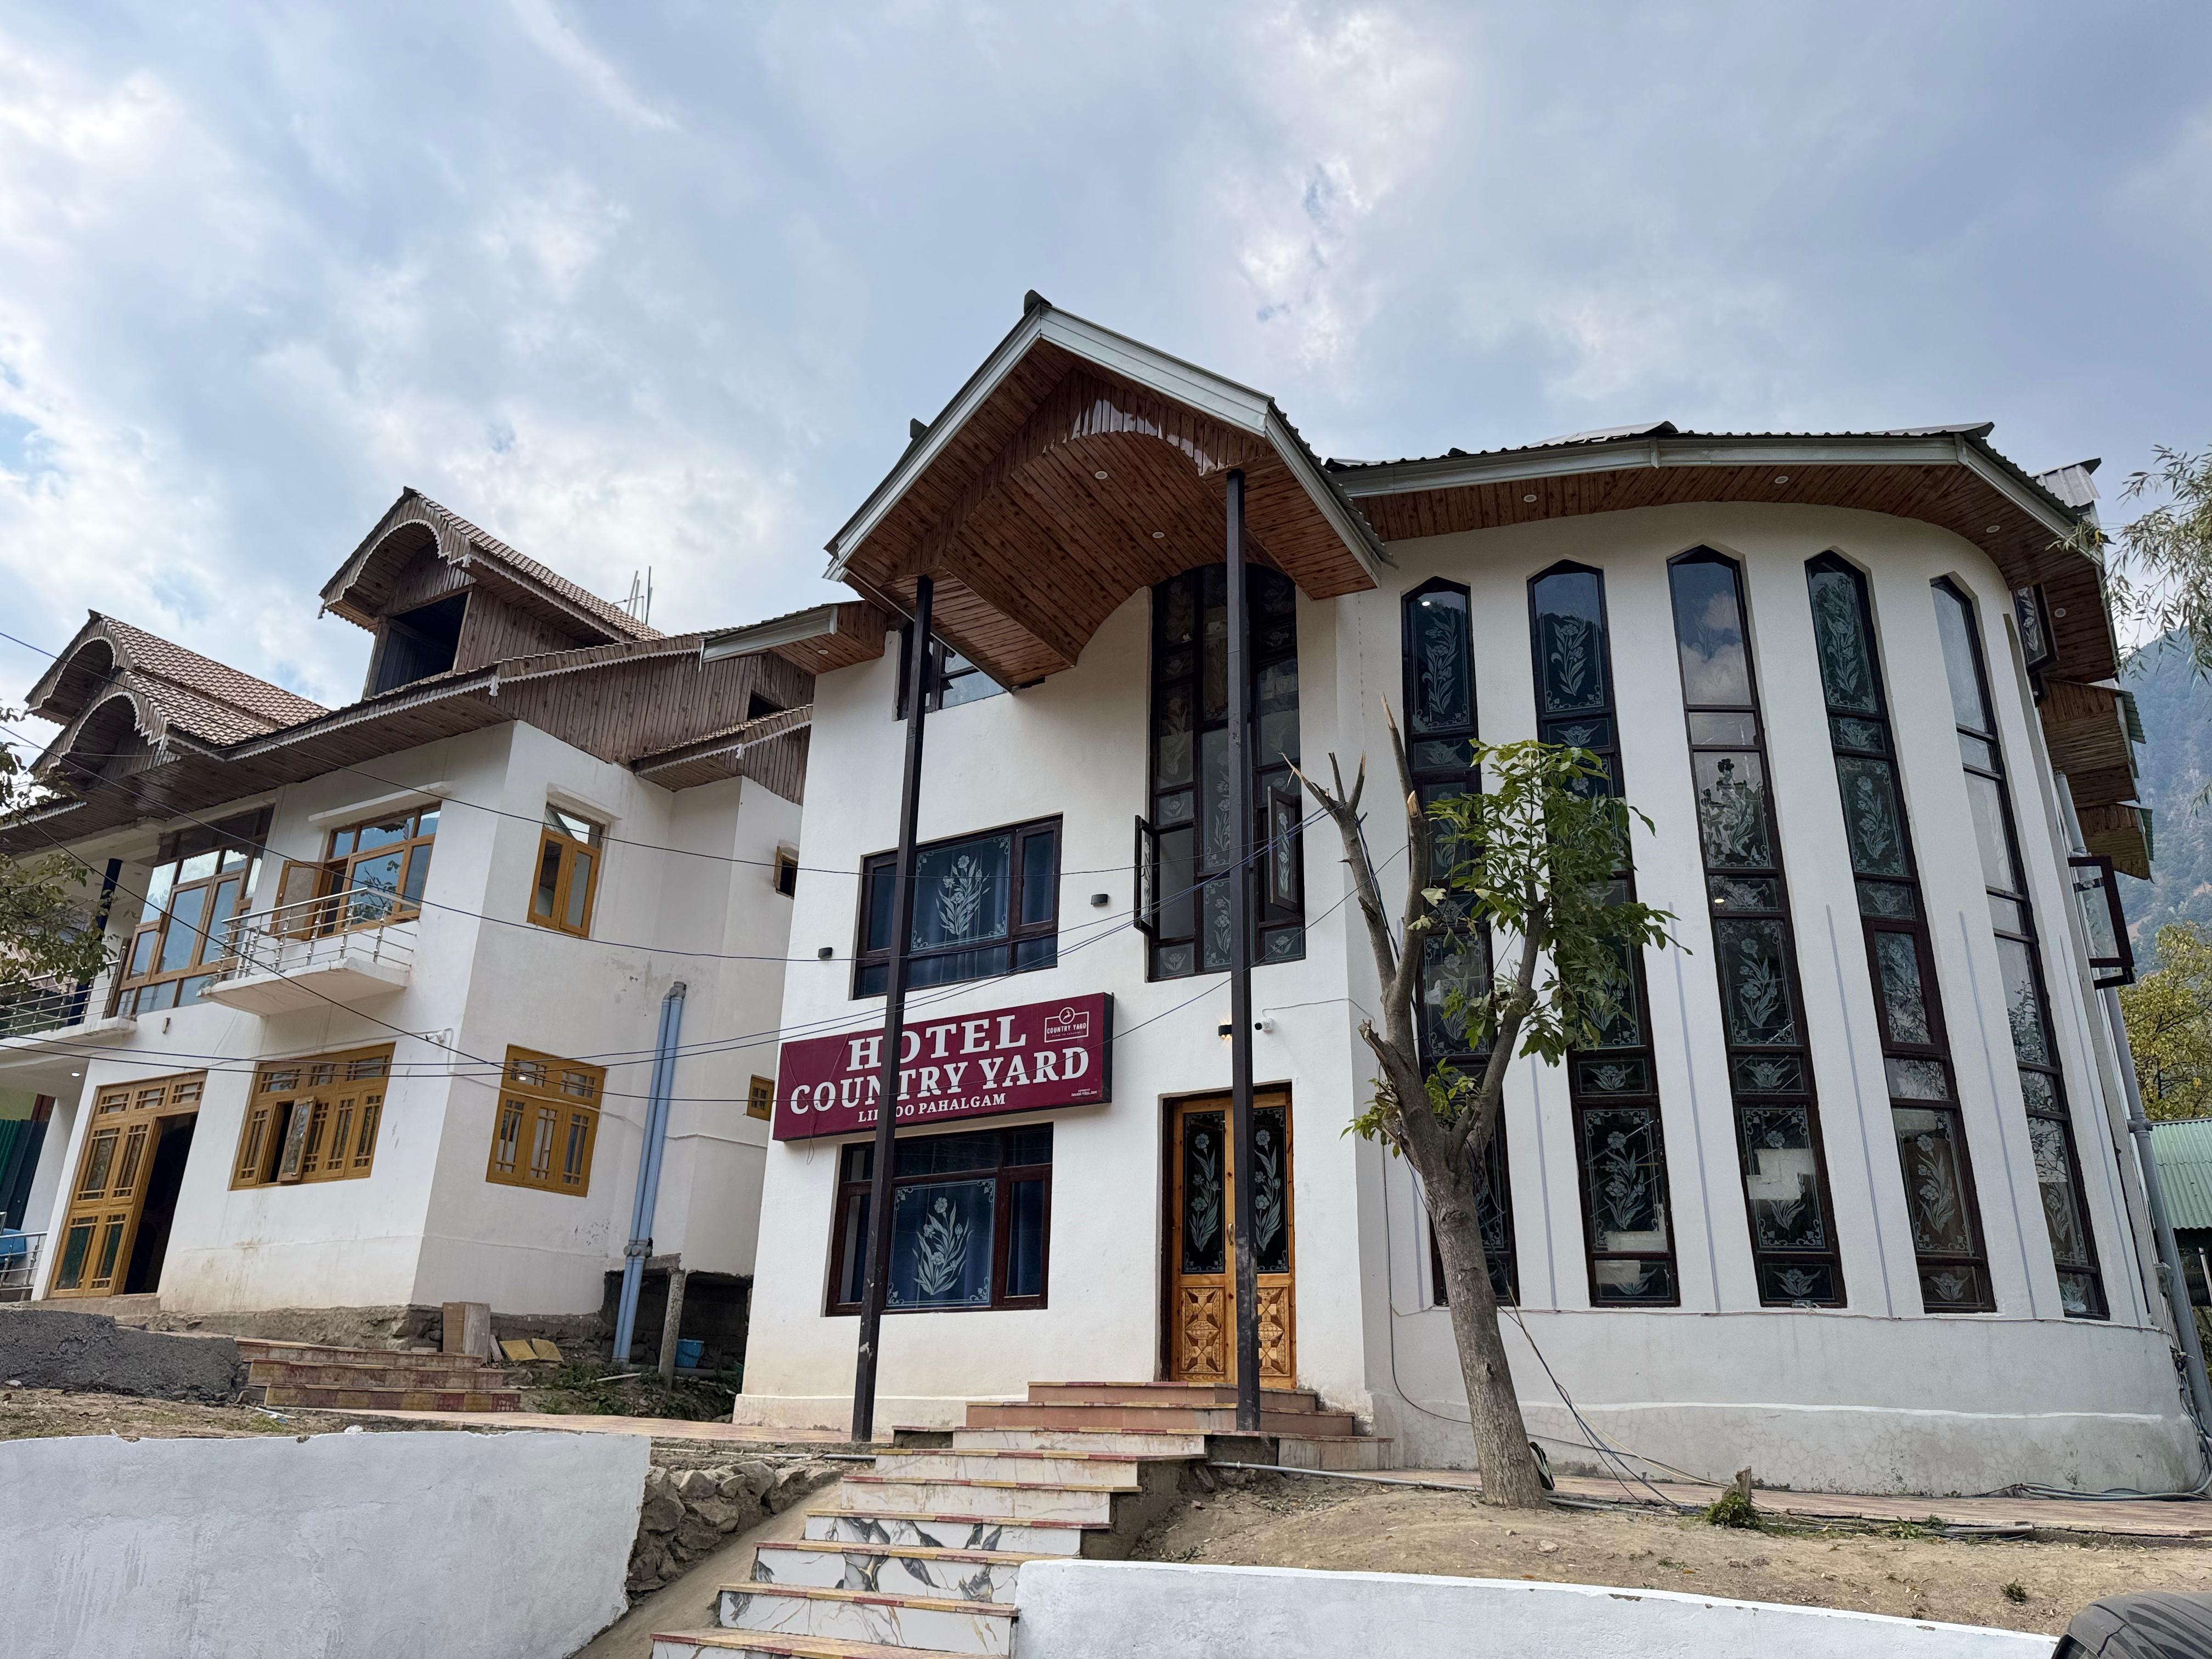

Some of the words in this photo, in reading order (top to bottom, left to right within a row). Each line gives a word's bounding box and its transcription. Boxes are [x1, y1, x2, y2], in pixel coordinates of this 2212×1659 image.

[846, 1015, 1027, 1072] HOTEL
[1047, 1025, 1071, 1034] COUNTRY
[790, 1062, 968, 1114] COUNTRY
[978, 1047, 1089, 1090] YARD
[918, 1093, 1006, 1114] PAHALGAM
